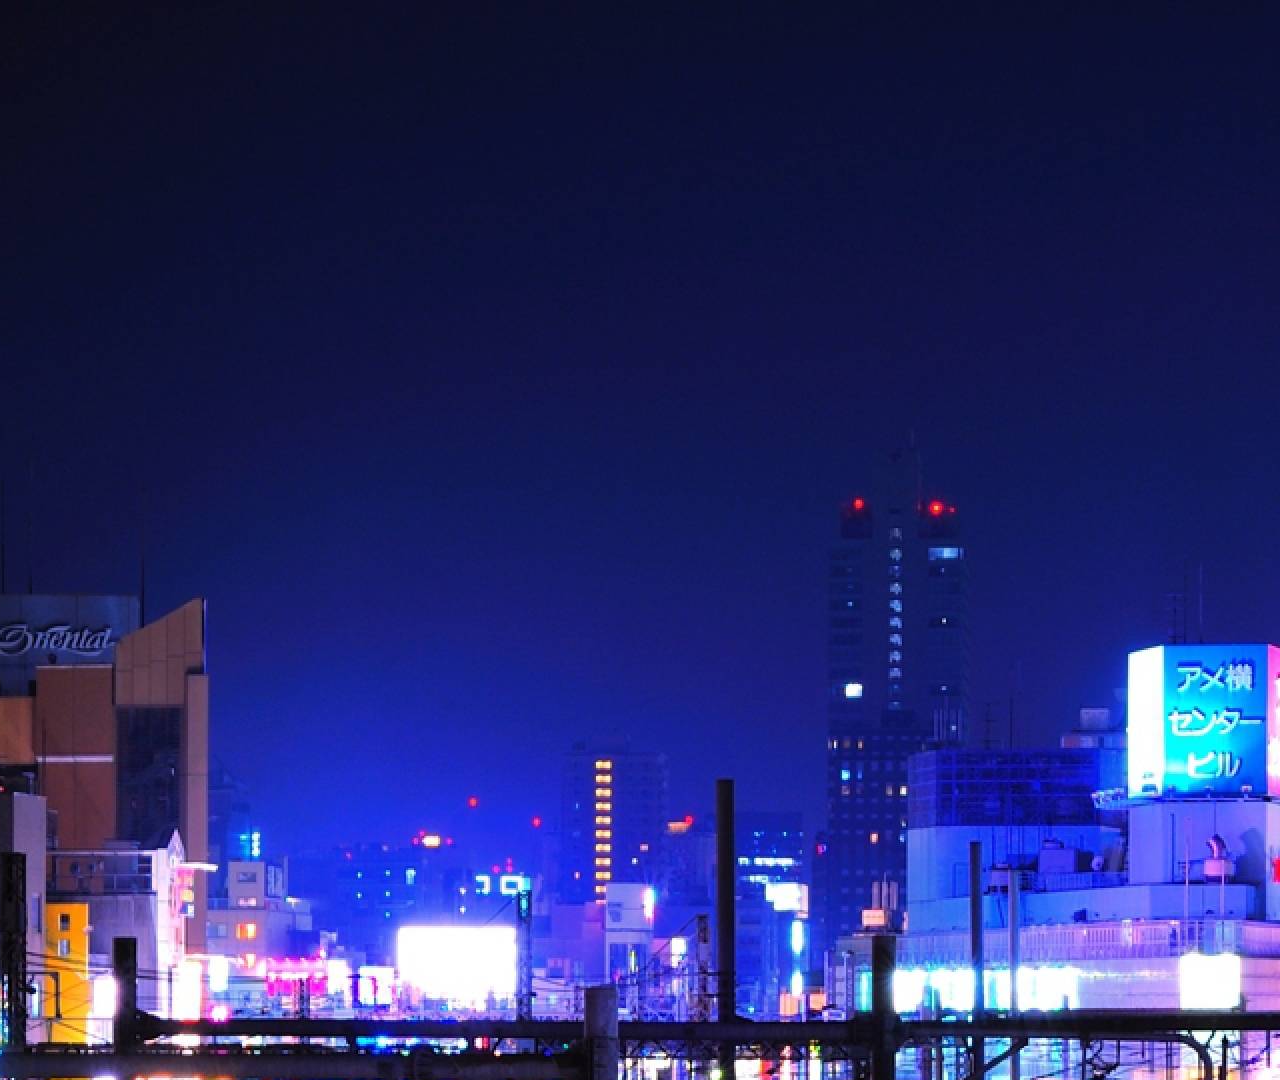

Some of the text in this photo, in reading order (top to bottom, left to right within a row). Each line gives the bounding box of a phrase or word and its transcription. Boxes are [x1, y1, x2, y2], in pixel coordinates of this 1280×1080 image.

[1175, 658, 1255, 693] アメ横
[1167, 706, 1265, 737] センター
[1186, 750, 1242, 779] ビル
